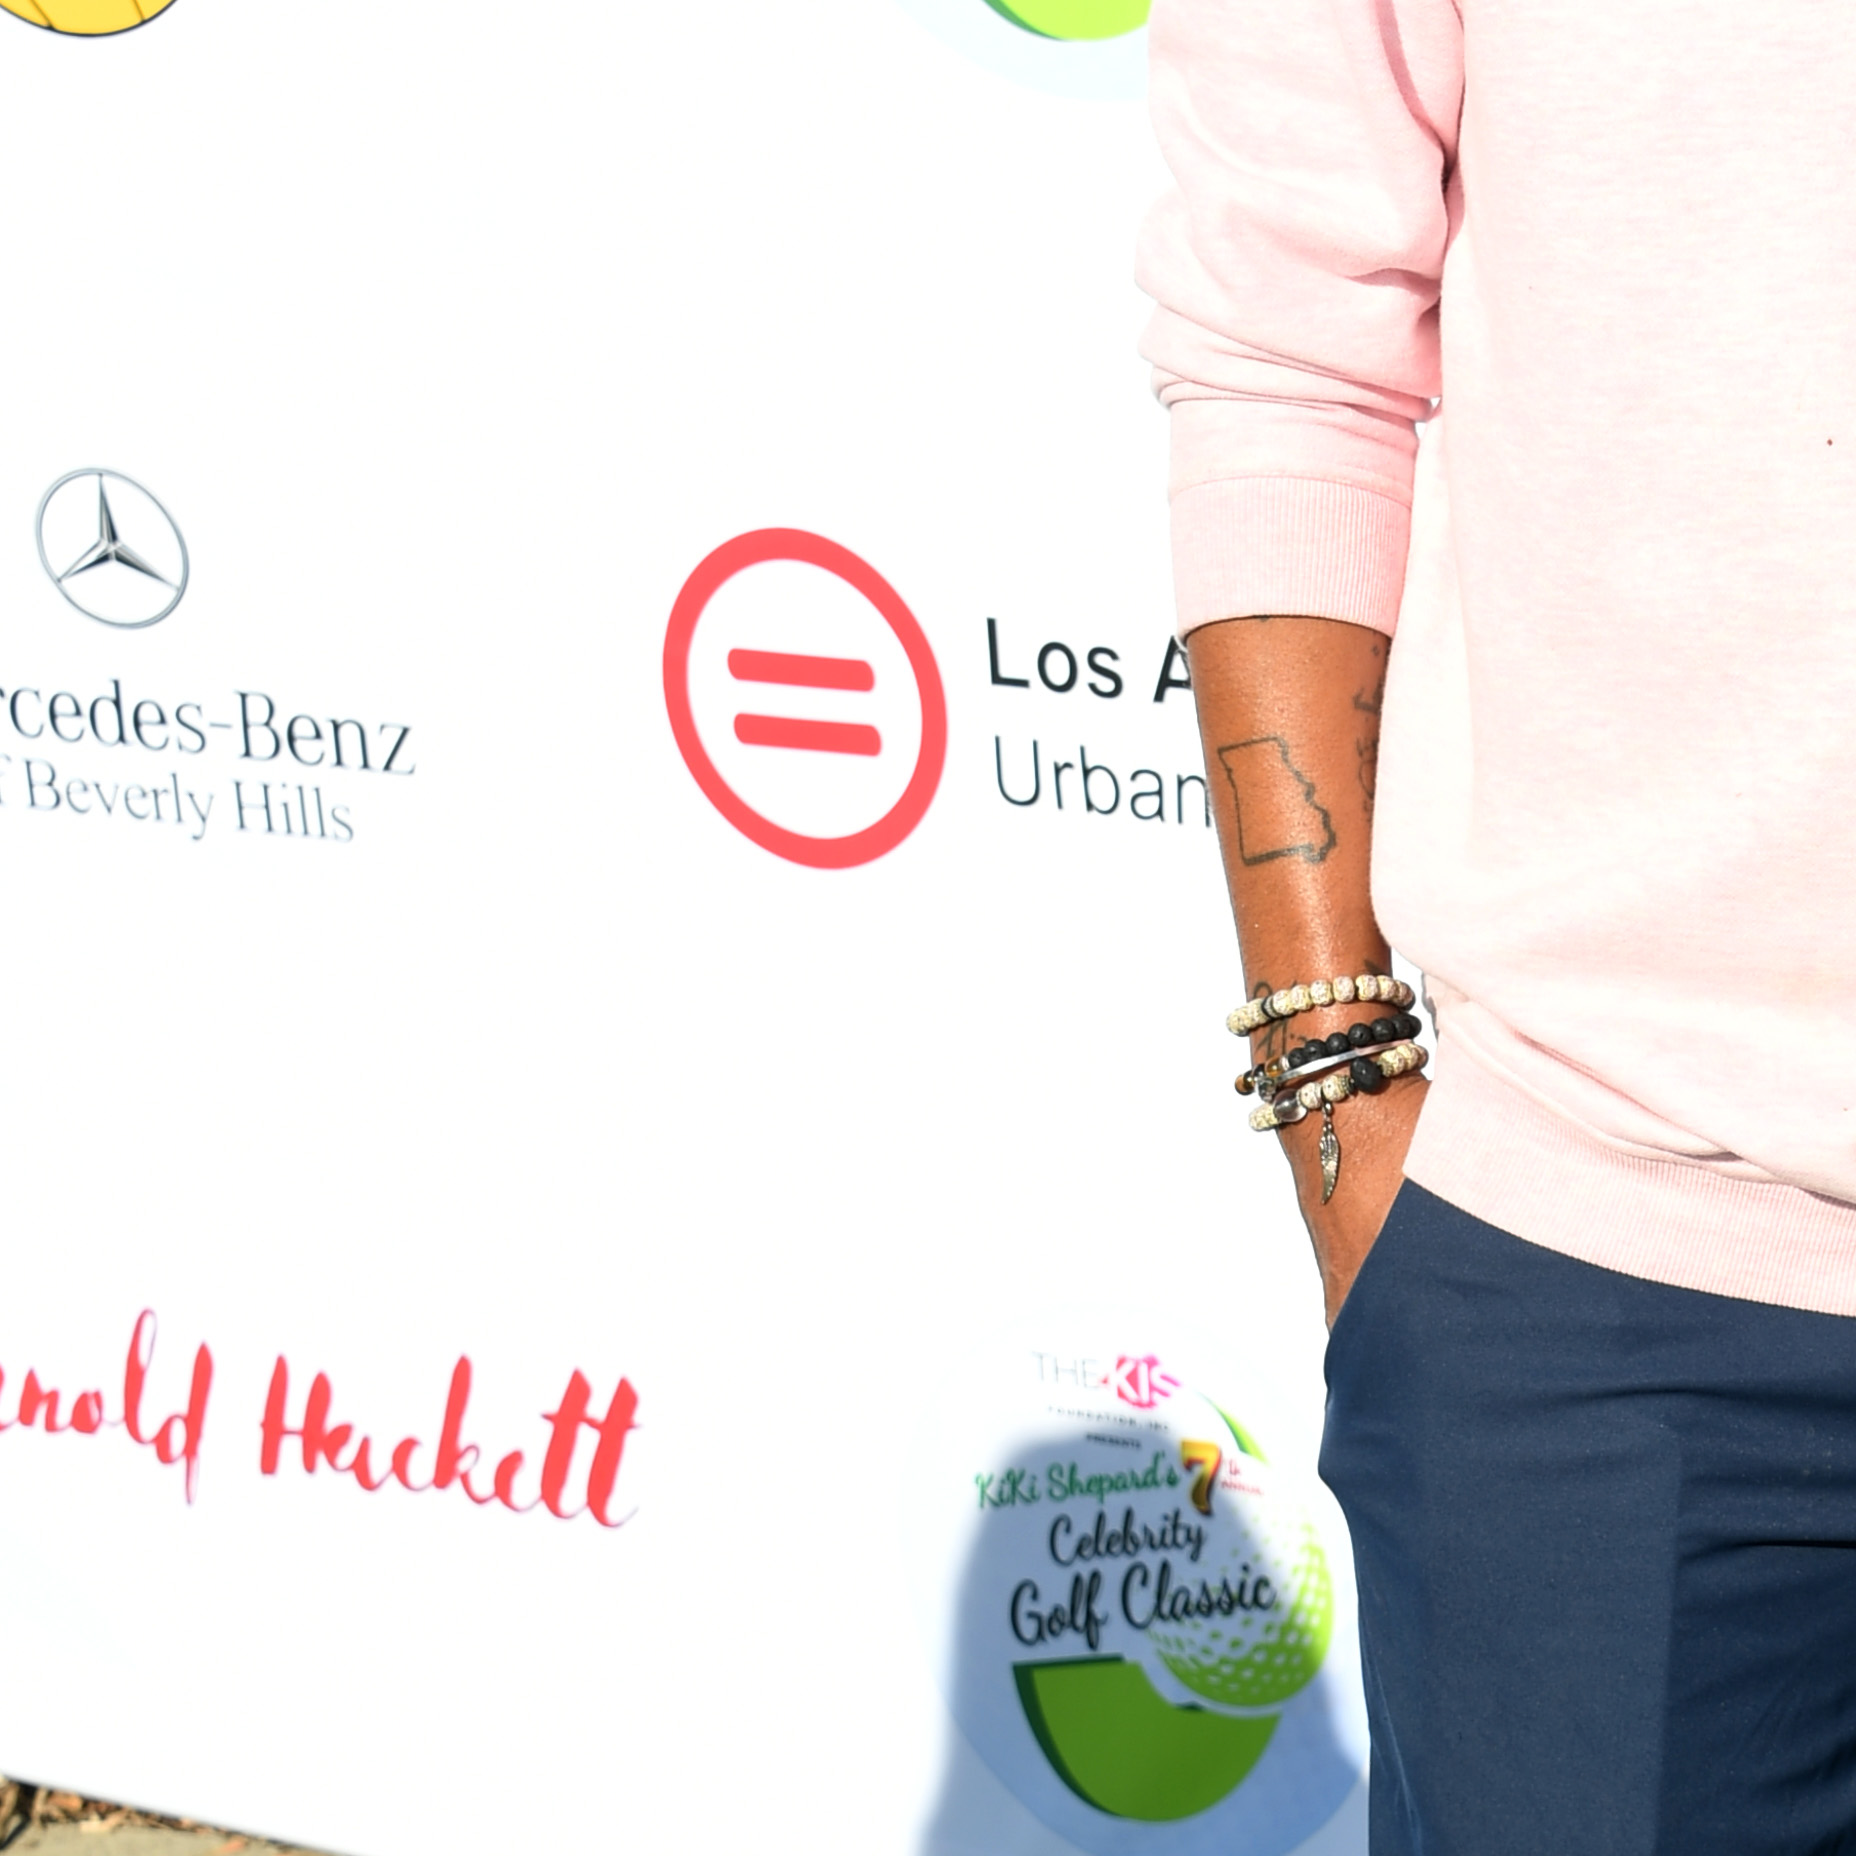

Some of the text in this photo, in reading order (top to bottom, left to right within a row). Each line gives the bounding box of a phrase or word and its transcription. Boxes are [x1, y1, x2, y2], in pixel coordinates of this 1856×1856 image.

[986, 617, 1124, 699] Los
[0, 678, 416, 776] cedes-Benz
[24, 756, 215, 841] Beverly
[232, 779, 356, 843] Hills
[994, 734, 1213, 828] Urban
[0, 1308, 641, 1528] nold Hackett
[1046, 1452, 1181, 1503] Shepard's
[1048, 1506, 1209, 1566] Celebrity
[1010, 1561, 1278, 1650] Golf Classic
